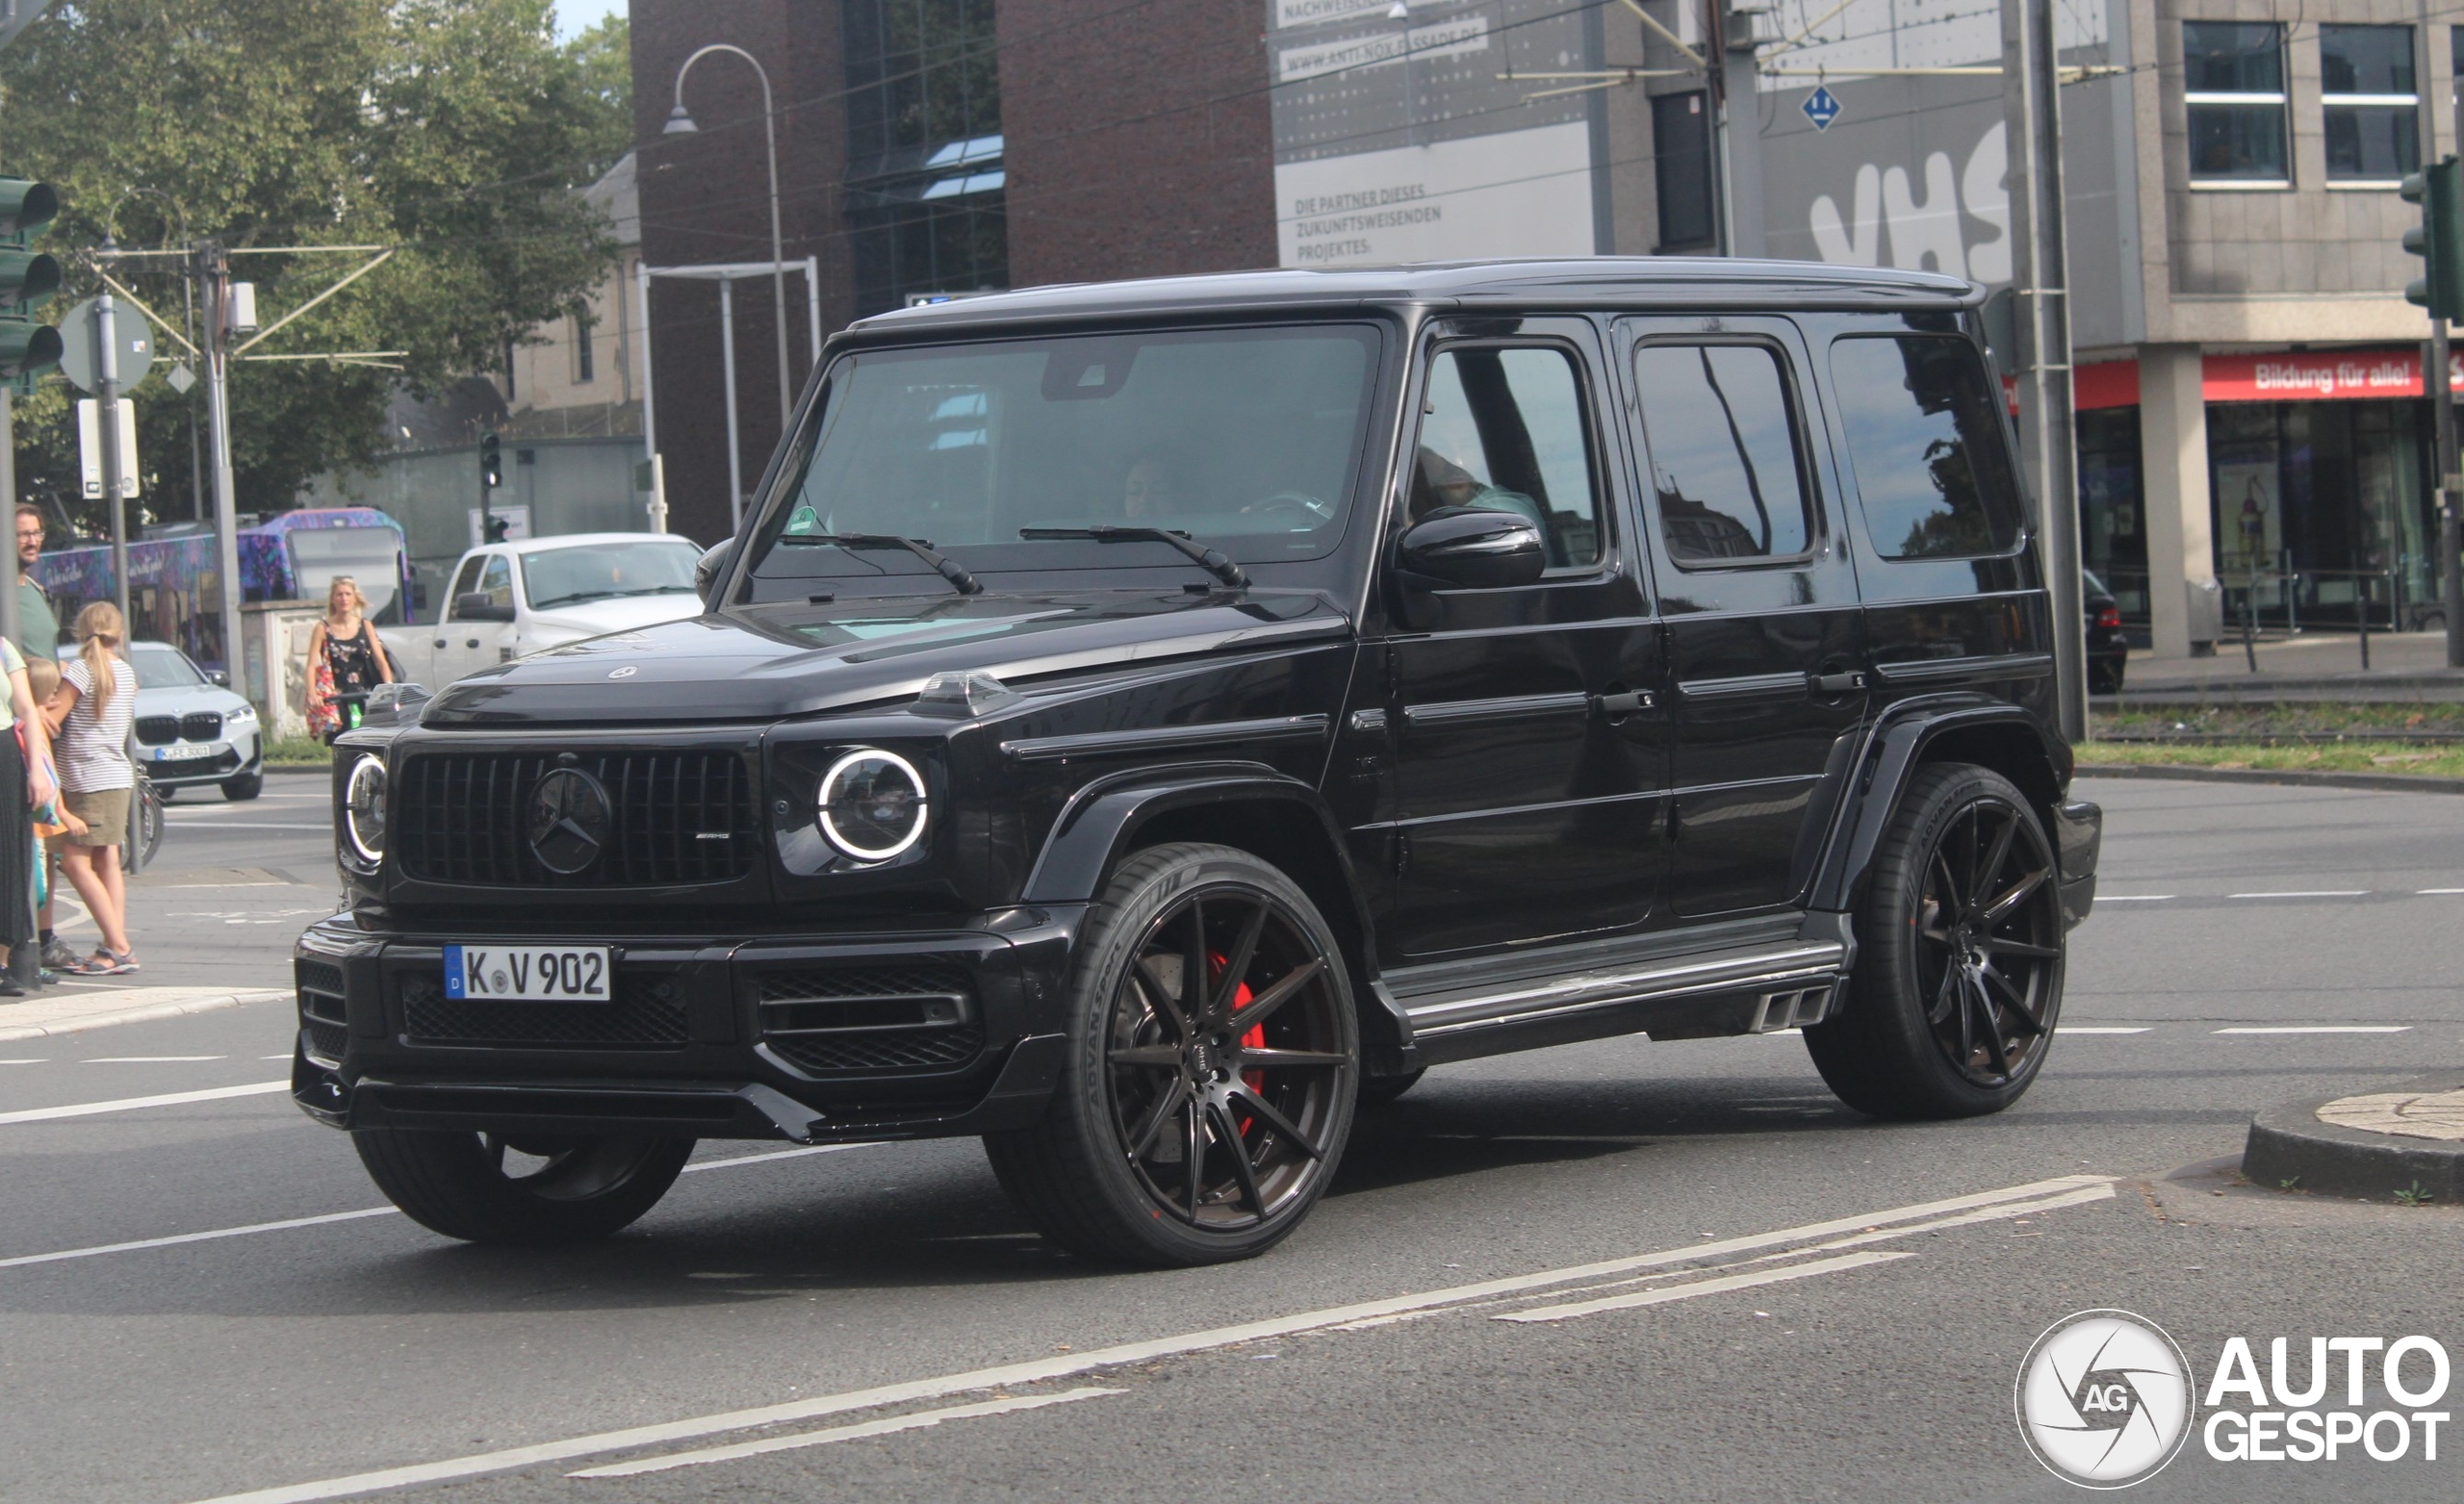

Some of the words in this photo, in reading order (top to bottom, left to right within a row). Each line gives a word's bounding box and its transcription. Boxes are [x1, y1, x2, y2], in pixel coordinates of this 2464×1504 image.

[1296, 198, 1317, 215] DIE
[1320, 191, 1377, 212] PARTNER
[1380, 184, 1425, 204] DIESES
[1296, 206, 1442, 238] ZUKUNFTSWEISENDEN
[2255, 364, 2333, 394] Bildung
[2337, 363, 2366, 388] für
[2370, 362, 2410, 387] alle!
[451, 978, 459, 989] D
[467, 952, 489, 993] K
[509, 953, 529, 994] V
[538, 952, 603, 994] 902
[1087, 1012, 1101, 1106] ADVAN
